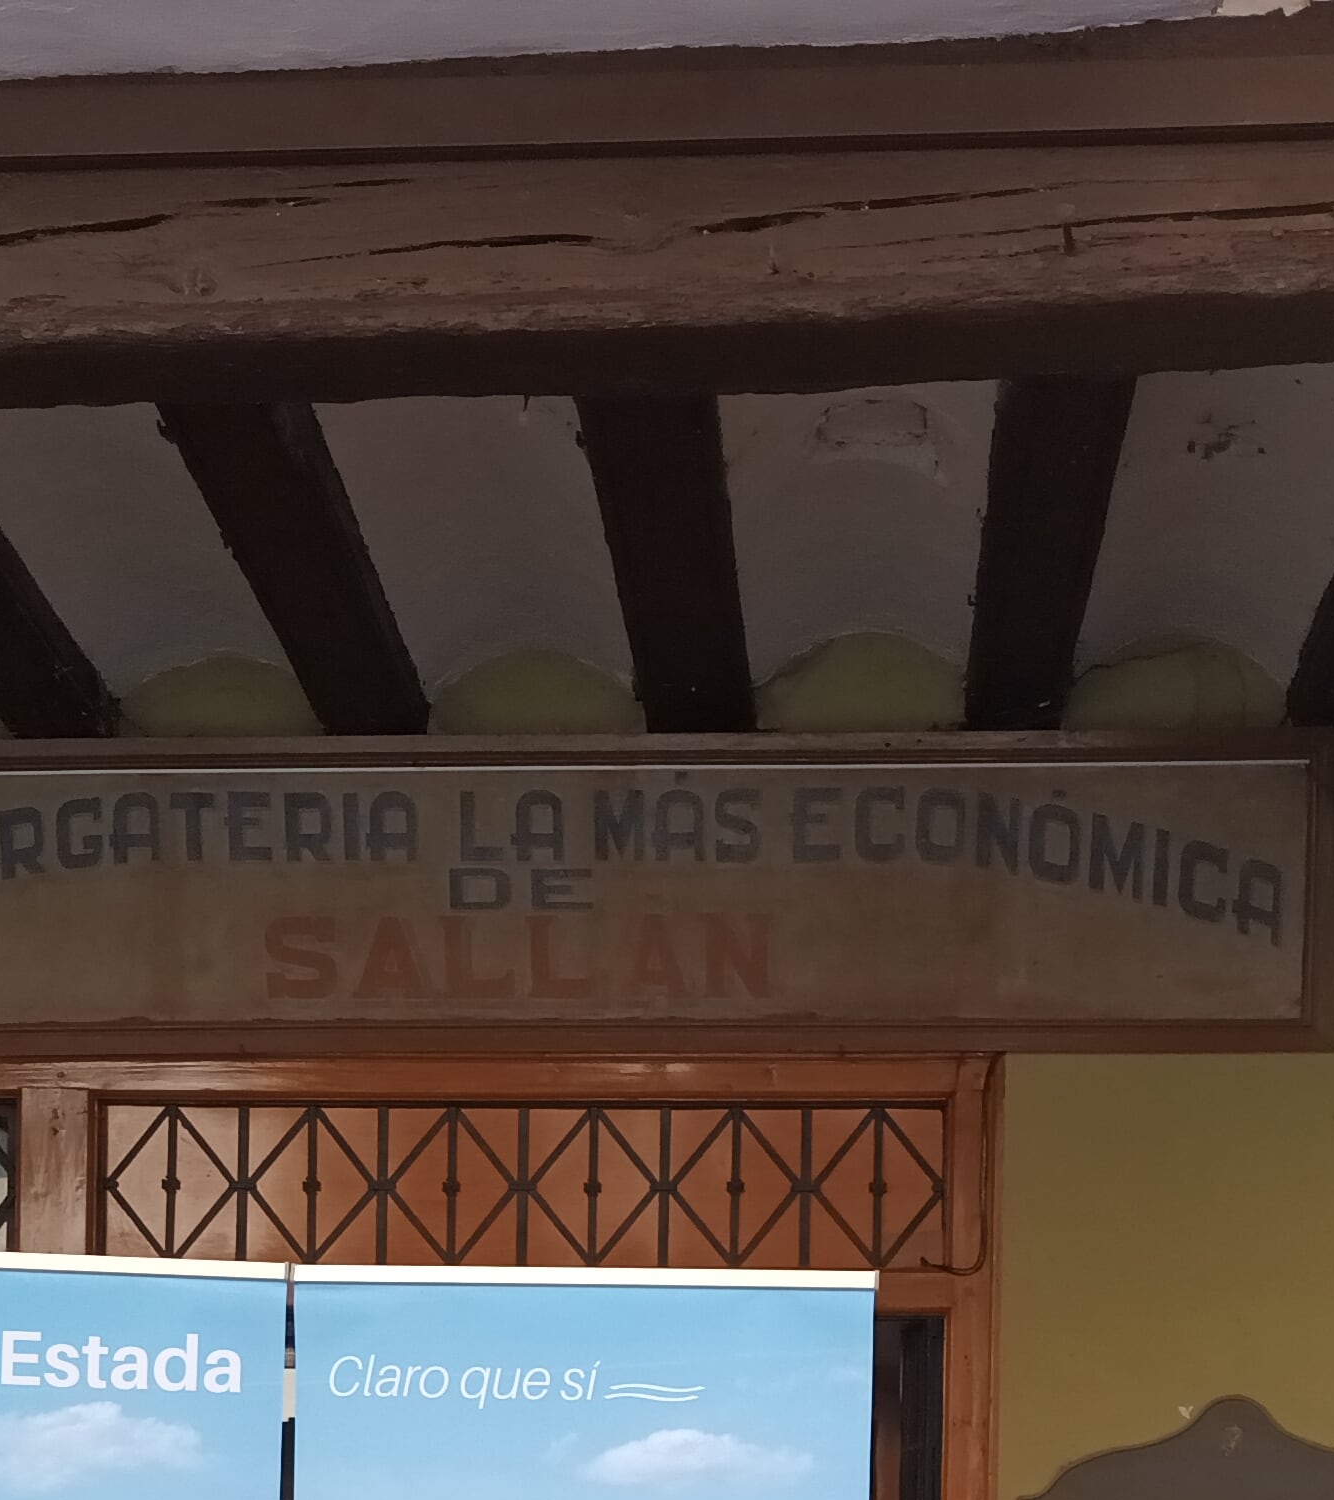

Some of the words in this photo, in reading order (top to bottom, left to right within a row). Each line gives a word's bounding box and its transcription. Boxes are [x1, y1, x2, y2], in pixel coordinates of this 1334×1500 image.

[449, 868, 594, 910] DE
[458, 789, 565, 863] LA
[593, 772, 760, 864] MÁS
[789, 786, 1283, 947] ECONÓMICA
[0, 1330, 242, 1394] Estada
[328, 1354, 453, 1399] Claro
[461, 1364, 551, 1409] que
[559, 1360, 602, 1401] sí
